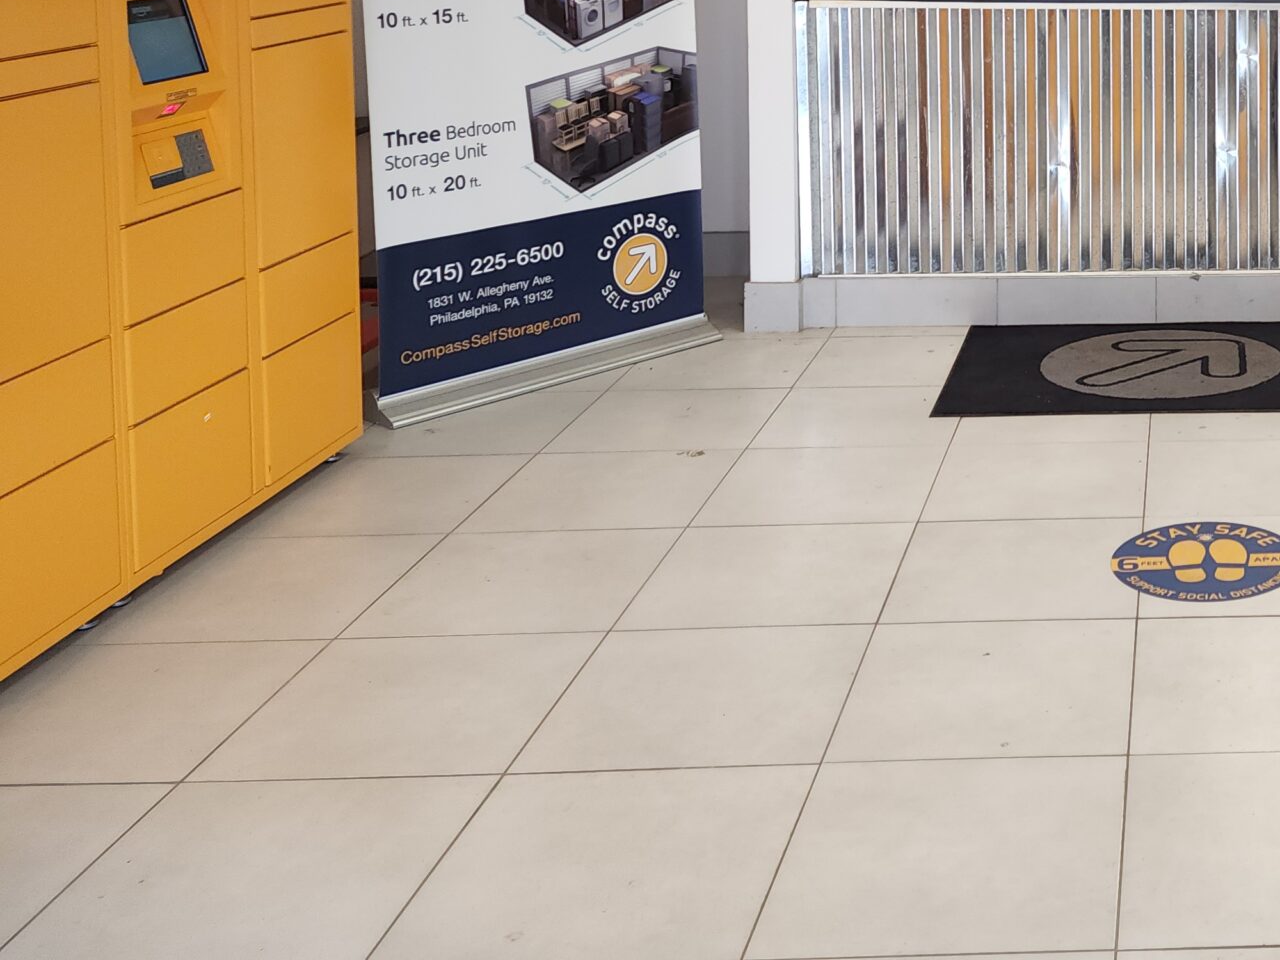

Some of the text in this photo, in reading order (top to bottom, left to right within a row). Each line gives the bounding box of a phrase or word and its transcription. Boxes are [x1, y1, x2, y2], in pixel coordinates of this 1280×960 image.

[376, 8, 469, 29] 10 ft. x 15 ft.
[383, 119, 517, 149] Three Bedroom
[384, 142, 488, 172] Storage Unit
[387, 174, 482, 202] 10 ft. x 20 ft.
[597, 213, 677, 261] compass
[412, 241, 565, 292] (215) 225-6500
[427, 274, 555, 309] 1831 W. Allegheny Ave.
[601, 269, 681, 314] SELF STORAGE
[429, 288, 554, 326] Philadelphia, PA 19132
[400, 311, 581, 365] CompassSelfStorage.com
[1135, 524, 1280, 548] STAY SAFE
[1117, 557, 1141, 572] 6
[1126, 575, 1177, 598] SUPPORT
[1178, 592, 1227, 601] SOCIAL
